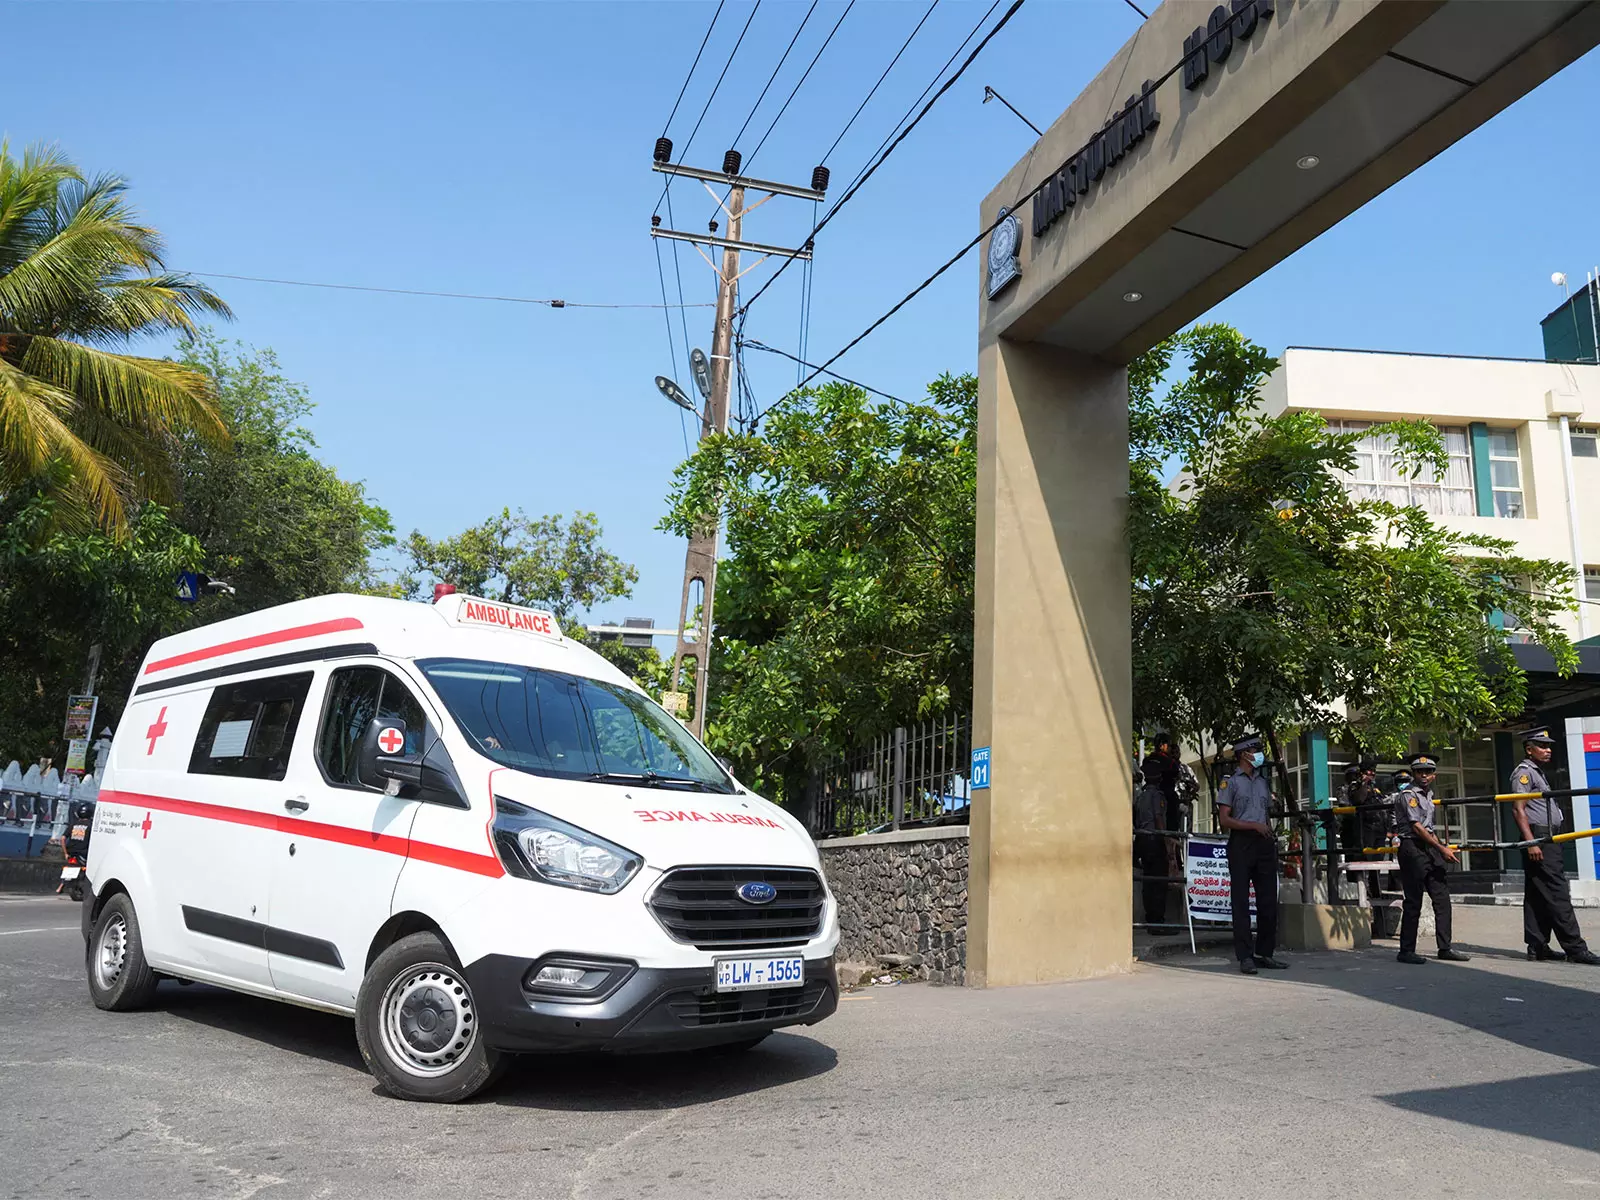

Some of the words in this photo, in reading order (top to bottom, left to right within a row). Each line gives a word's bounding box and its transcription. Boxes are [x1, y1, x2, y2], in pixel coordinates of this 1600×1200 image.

[1183, 0, 1275, 91] HOS
[466, 602, 551, 634] AMBULANCE
[973, 751, 989, 762] GATE
[974, 764, 988, 785] 01
[749, 884, 771, 898] Ford
[719, 973, 730, 984] WP
